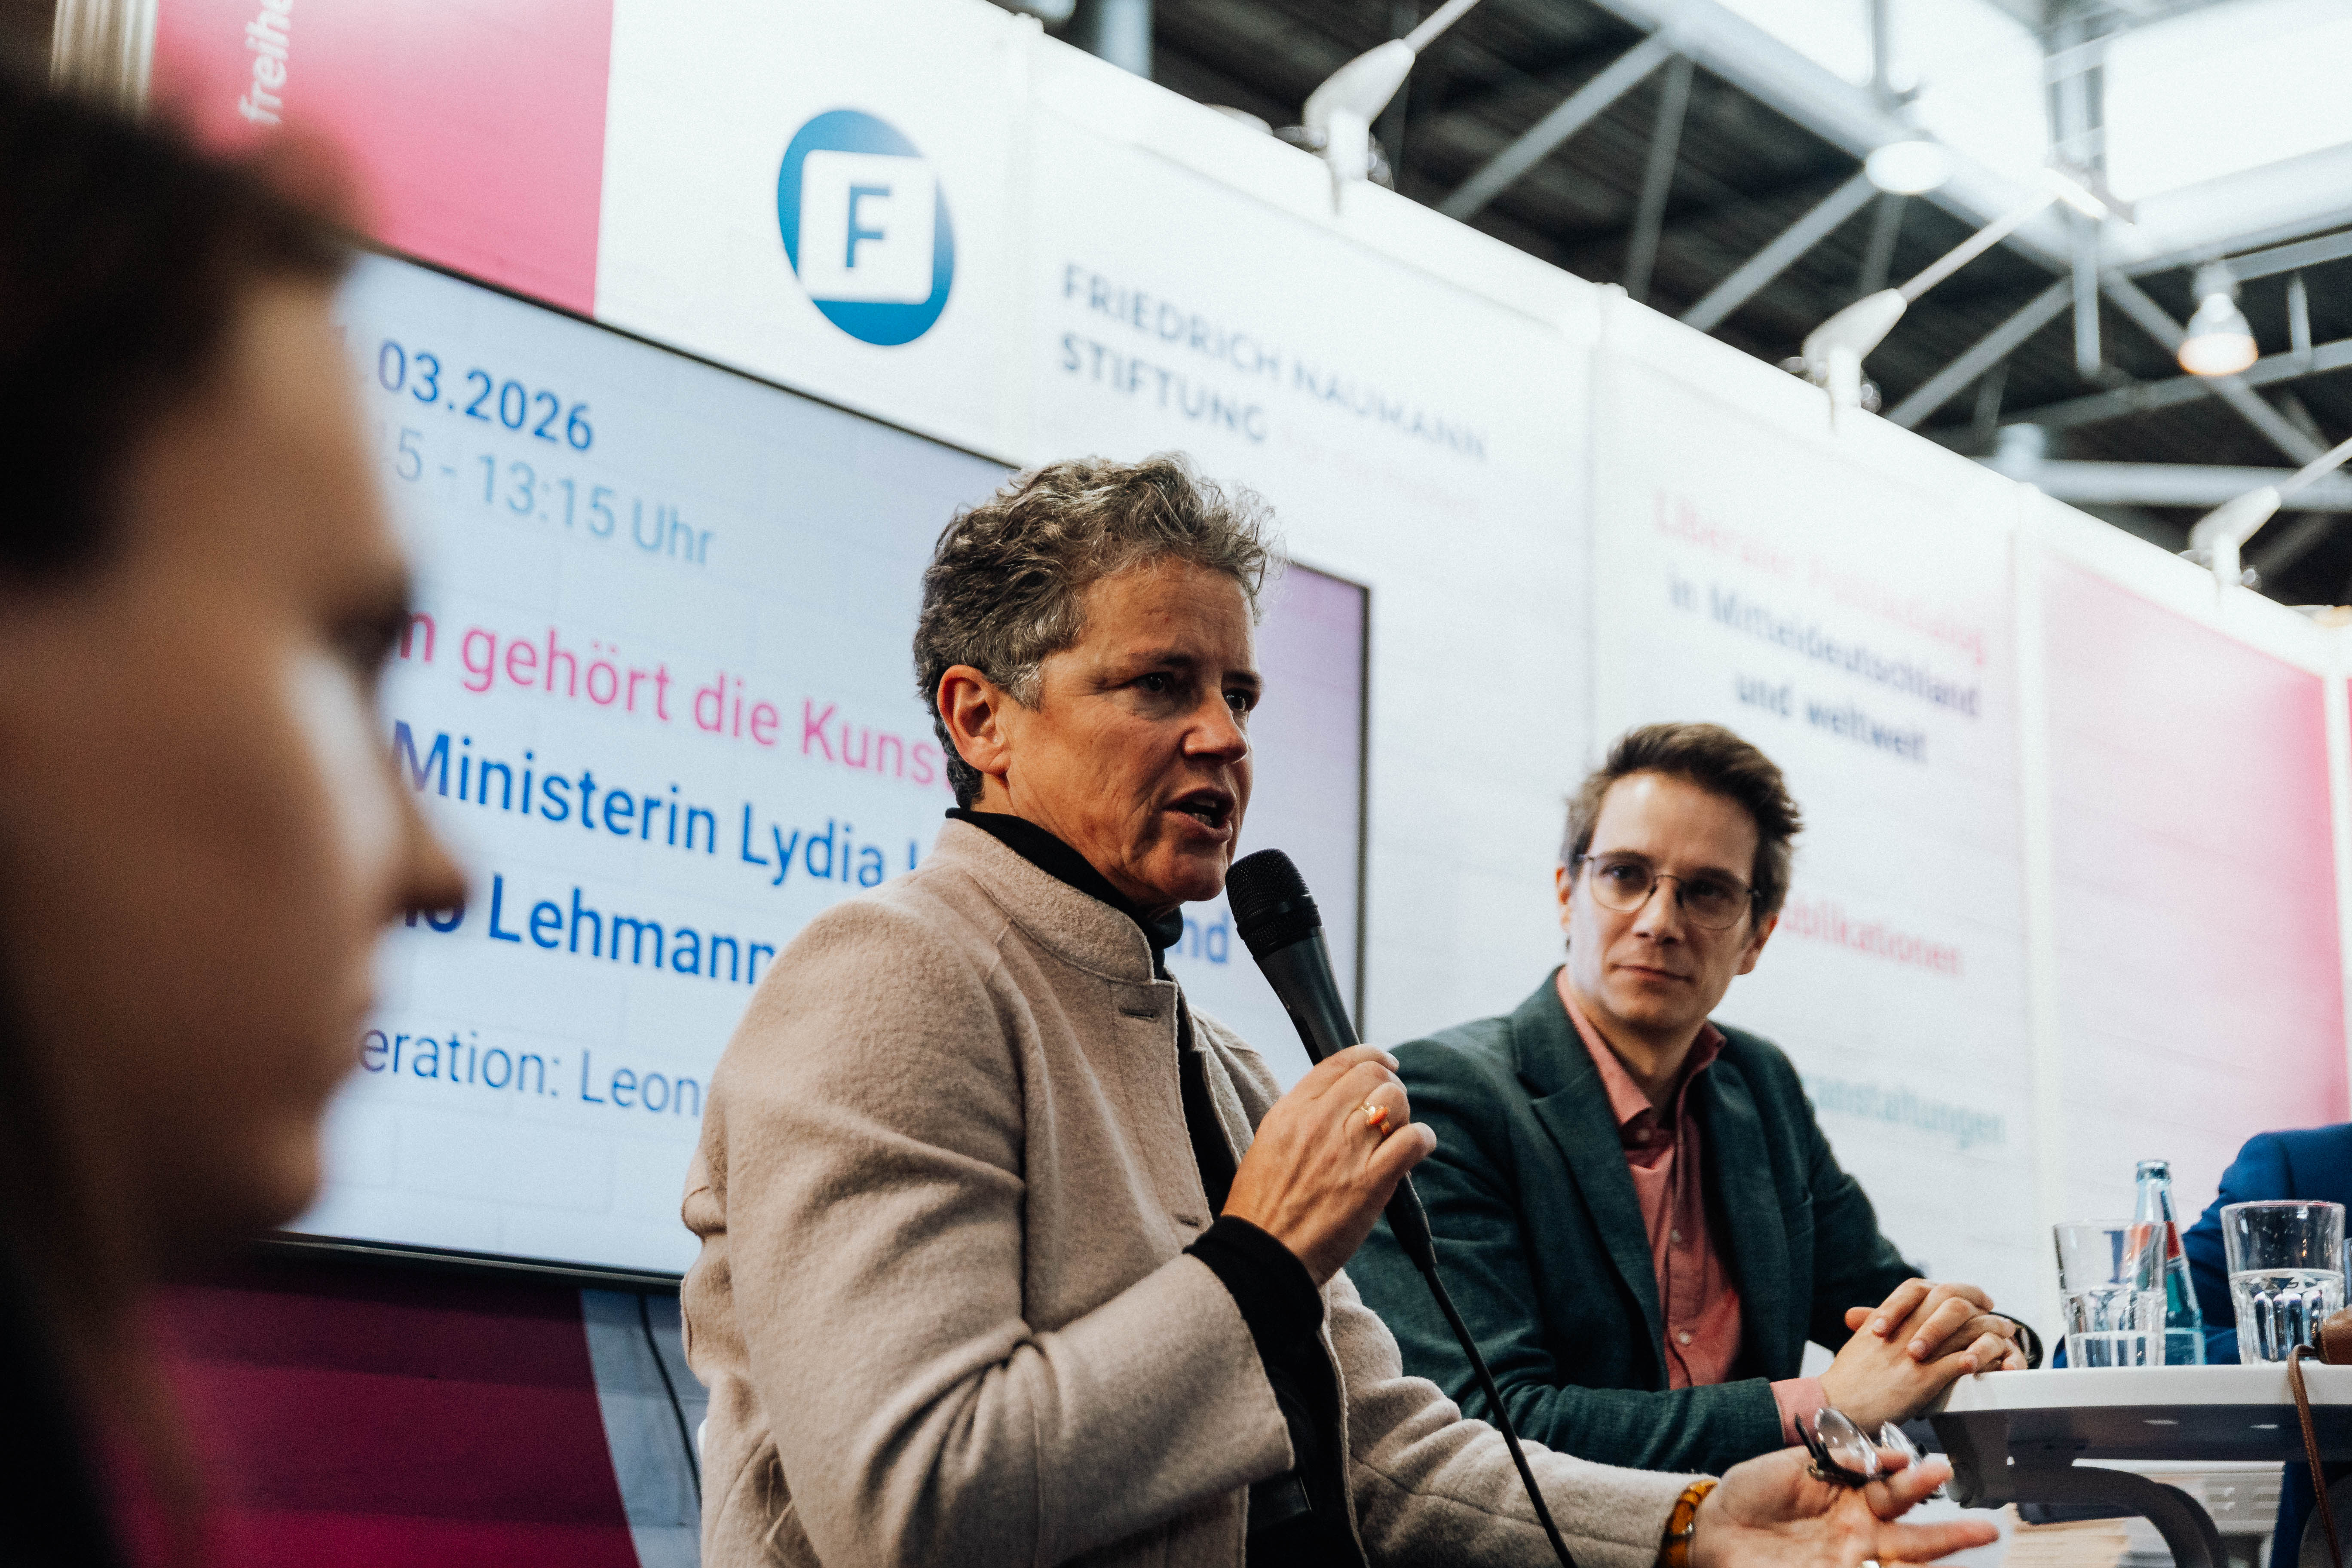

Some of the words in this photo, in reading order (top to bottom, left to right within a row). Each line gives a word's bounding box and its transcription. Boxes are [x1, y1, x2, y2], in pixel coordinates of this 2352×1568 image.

[846, 184, 891, 268] F
[378, 340, 593, 450] 03.2026
[1060, 332, 1267, 444] STIFTUNG
[1062, 262, 1281, 381] FRIEDRICH
[1293, 361, 1488, 461] NAUMANN
[478, 455, 615, 539] 13:15
[632, 497, 715, 566] Uhr
[462, 626, 671, 720] gehört
[693, 673, 779, 746] die
[1735, 671, 1793, 718] und
[1805, 697, 1927, 764] weltweit
[392, 719, 717, 854] Ministerin
[741, 801, 884, 889] Lydia
[1166, 909, 1229, 964] nd
[359, 1029, 560, 1097] eration:
[581, 1049, 710, 1118] Leon
